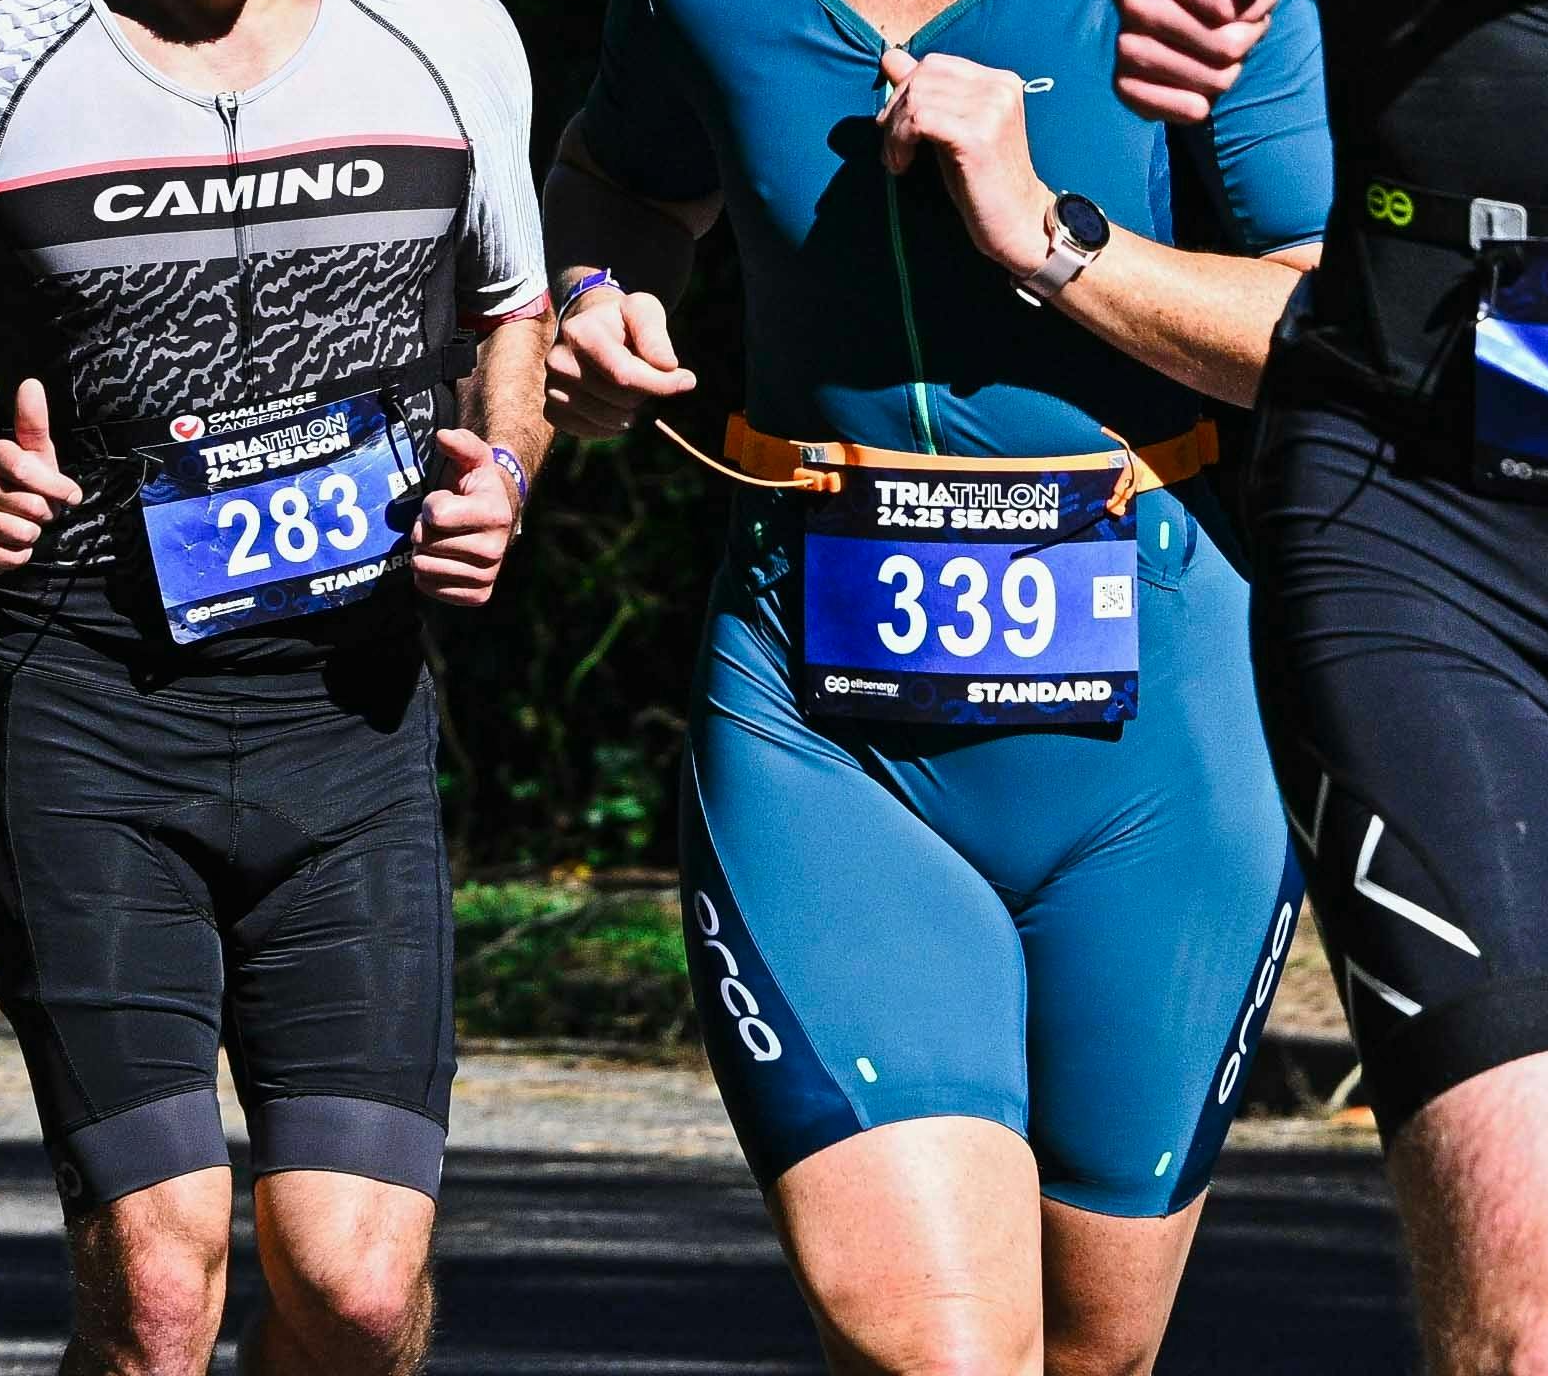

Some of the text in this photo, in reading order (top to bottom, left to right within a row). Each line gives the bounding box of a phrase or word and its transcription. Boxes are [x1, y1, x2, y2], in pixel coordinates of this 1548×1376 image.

[93, 159, 385, 222] CAMINO
[208, 392, 317, 424] CHALLENGE
[208, 407, 308, 435] CANBERRA
[200, 412, 349, 467] TRIATHLON
[205, 432, 351, 484] 24.25 SEASON
[874, 480, 1059, 509] TRIATHLON
[876, 505, 1059, 530] 24.25 SEASON
[216, 473, 369, 578] 283
[876, 553, 1057, 659] 339
[967, 679, 1112, 704] STANDARD
[694, 889, 783, 1062] orca
[1217, 901, 1293, 1105] orca
